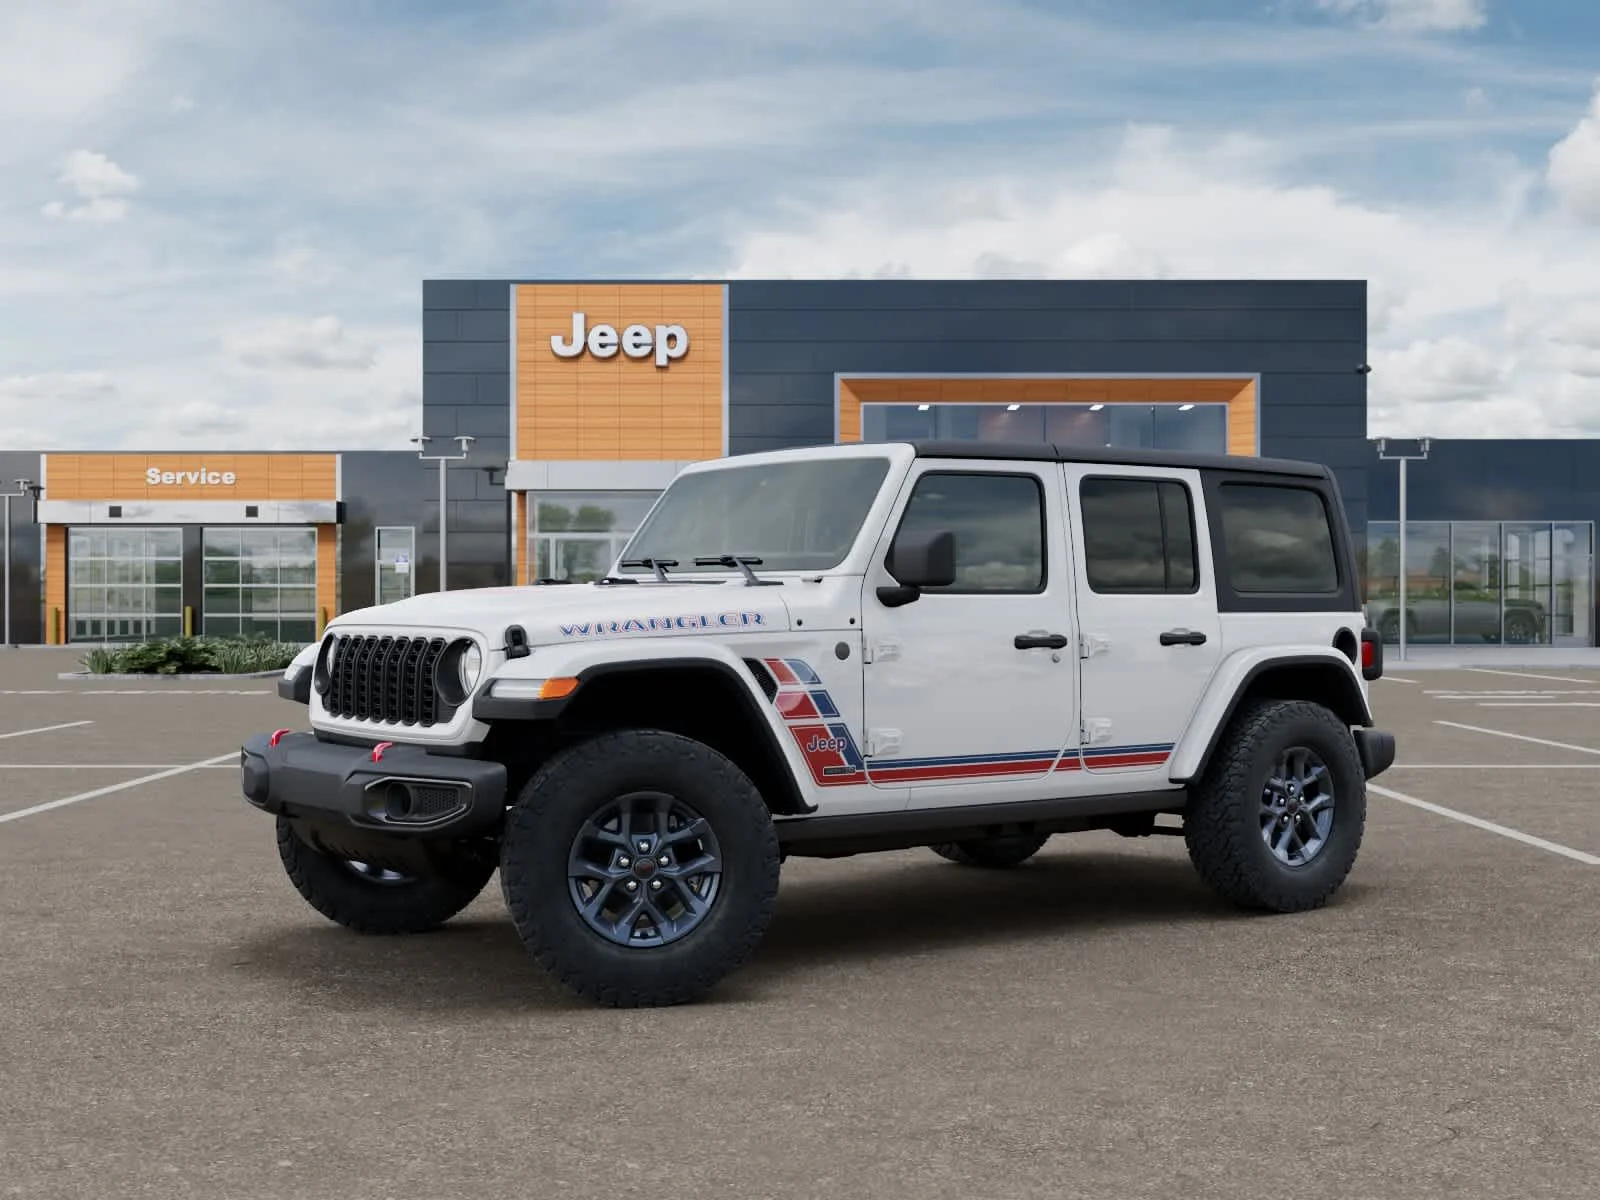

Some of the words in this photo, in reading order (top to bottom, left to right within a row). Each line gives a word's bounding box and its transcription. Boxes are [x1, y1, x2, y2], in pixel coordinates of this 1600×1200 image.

[550, 312, 689, 366] Jeep
[146, 467, 236, 485] Service
[559, 609, 766, 636] WRANGLER
[806, 735, 847, 753] Jeep
